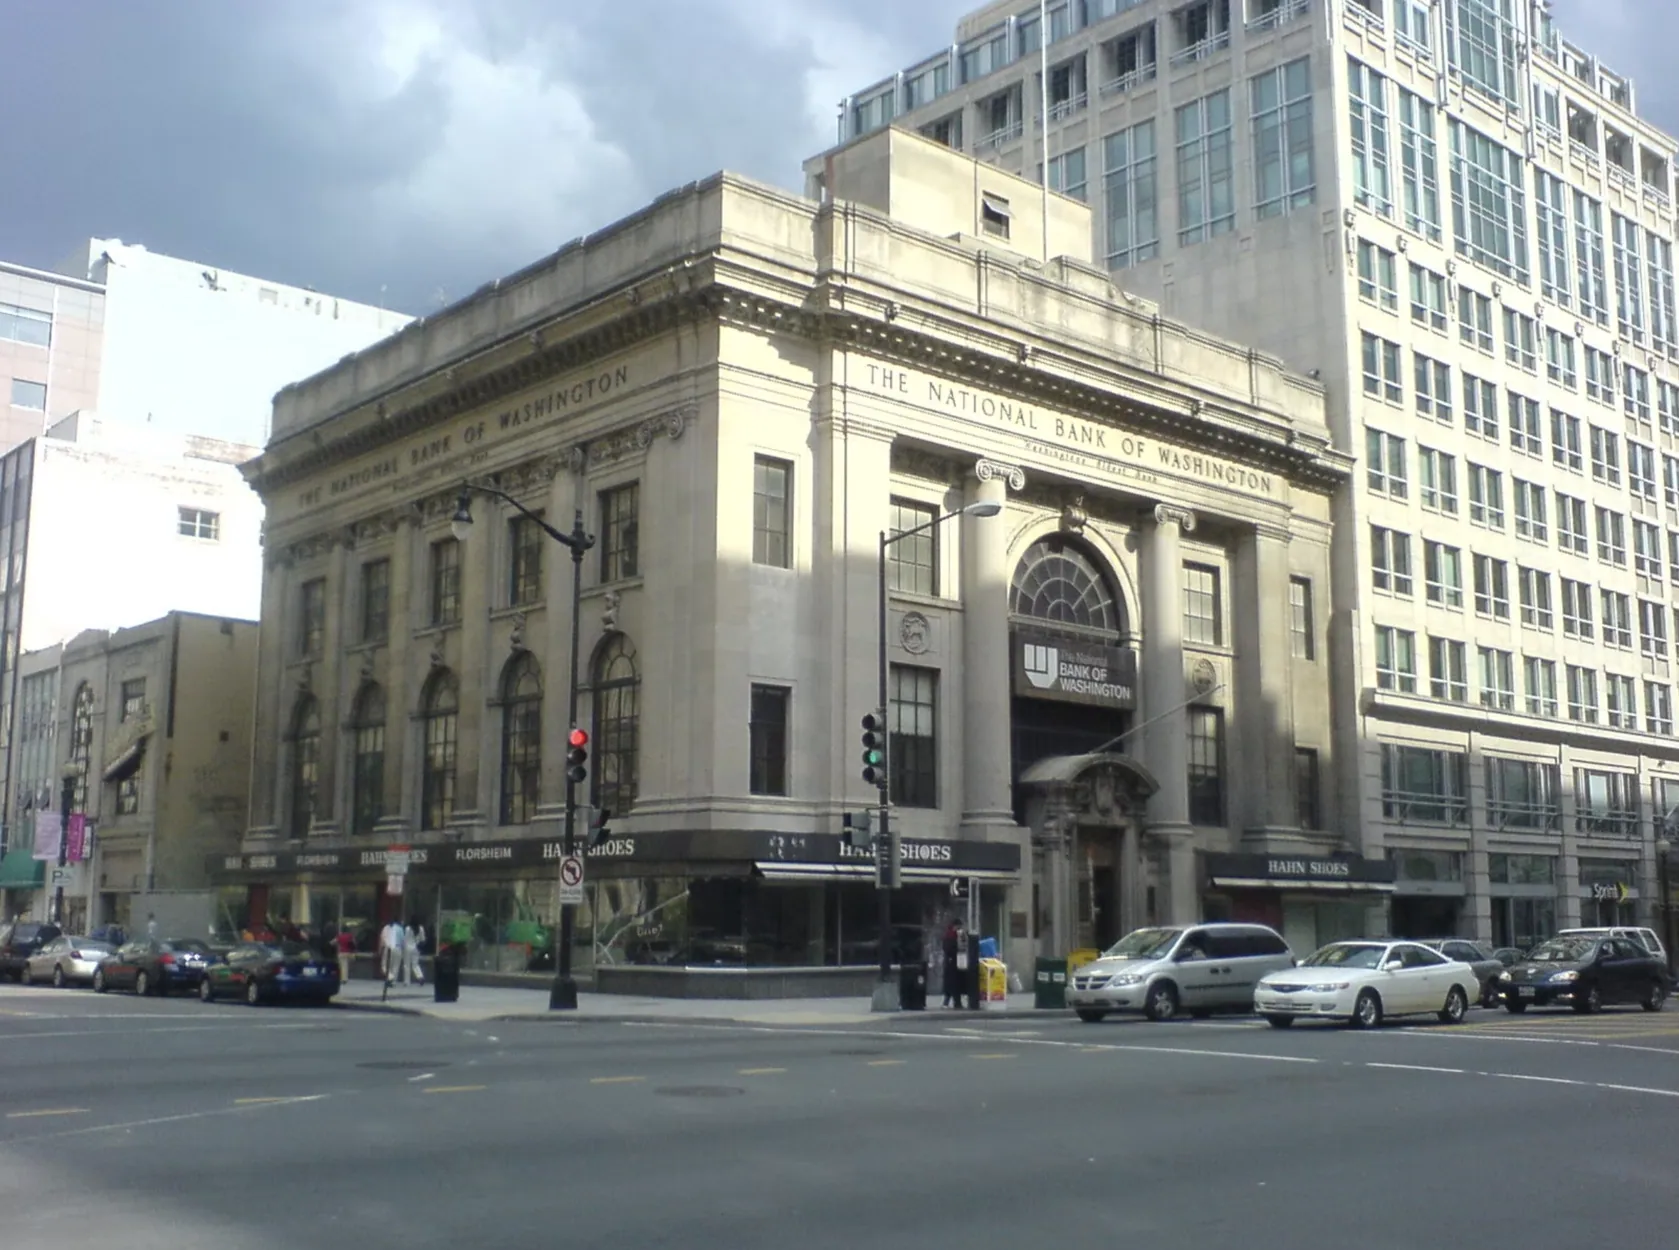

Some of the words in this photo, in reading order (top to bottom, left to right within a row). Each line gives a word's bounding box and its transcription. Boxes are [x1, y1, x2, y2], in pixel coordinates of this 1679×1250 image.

[411, 434, 451, 466] BANK
[463, 421, 486, 444] OF
[499, 366, 628, 429] WASHINGTON
[867, 364, 908, 393] THE
[929, 382, 1038, 430] NATIONAL
[1055, 418, 1107, 449] BANK
[1121, 437, 1145, 458] OF
[1158, 446, 1271, 493] WASHINGTON
[1060, 661, 1090, 679] BANK
[1091, 668, 1108, 682] OF
[1060, 677, 1131, 699] WASHINGTON
[456, 847, 512, 860] FLORSHEIM
[900, 843, 951, 860] SHOES
[1268, 860, 1305, 874] HAHN
[1309, 861, 1349, 876] SHOES
[1594, 883, 1618, 902] Sprint
